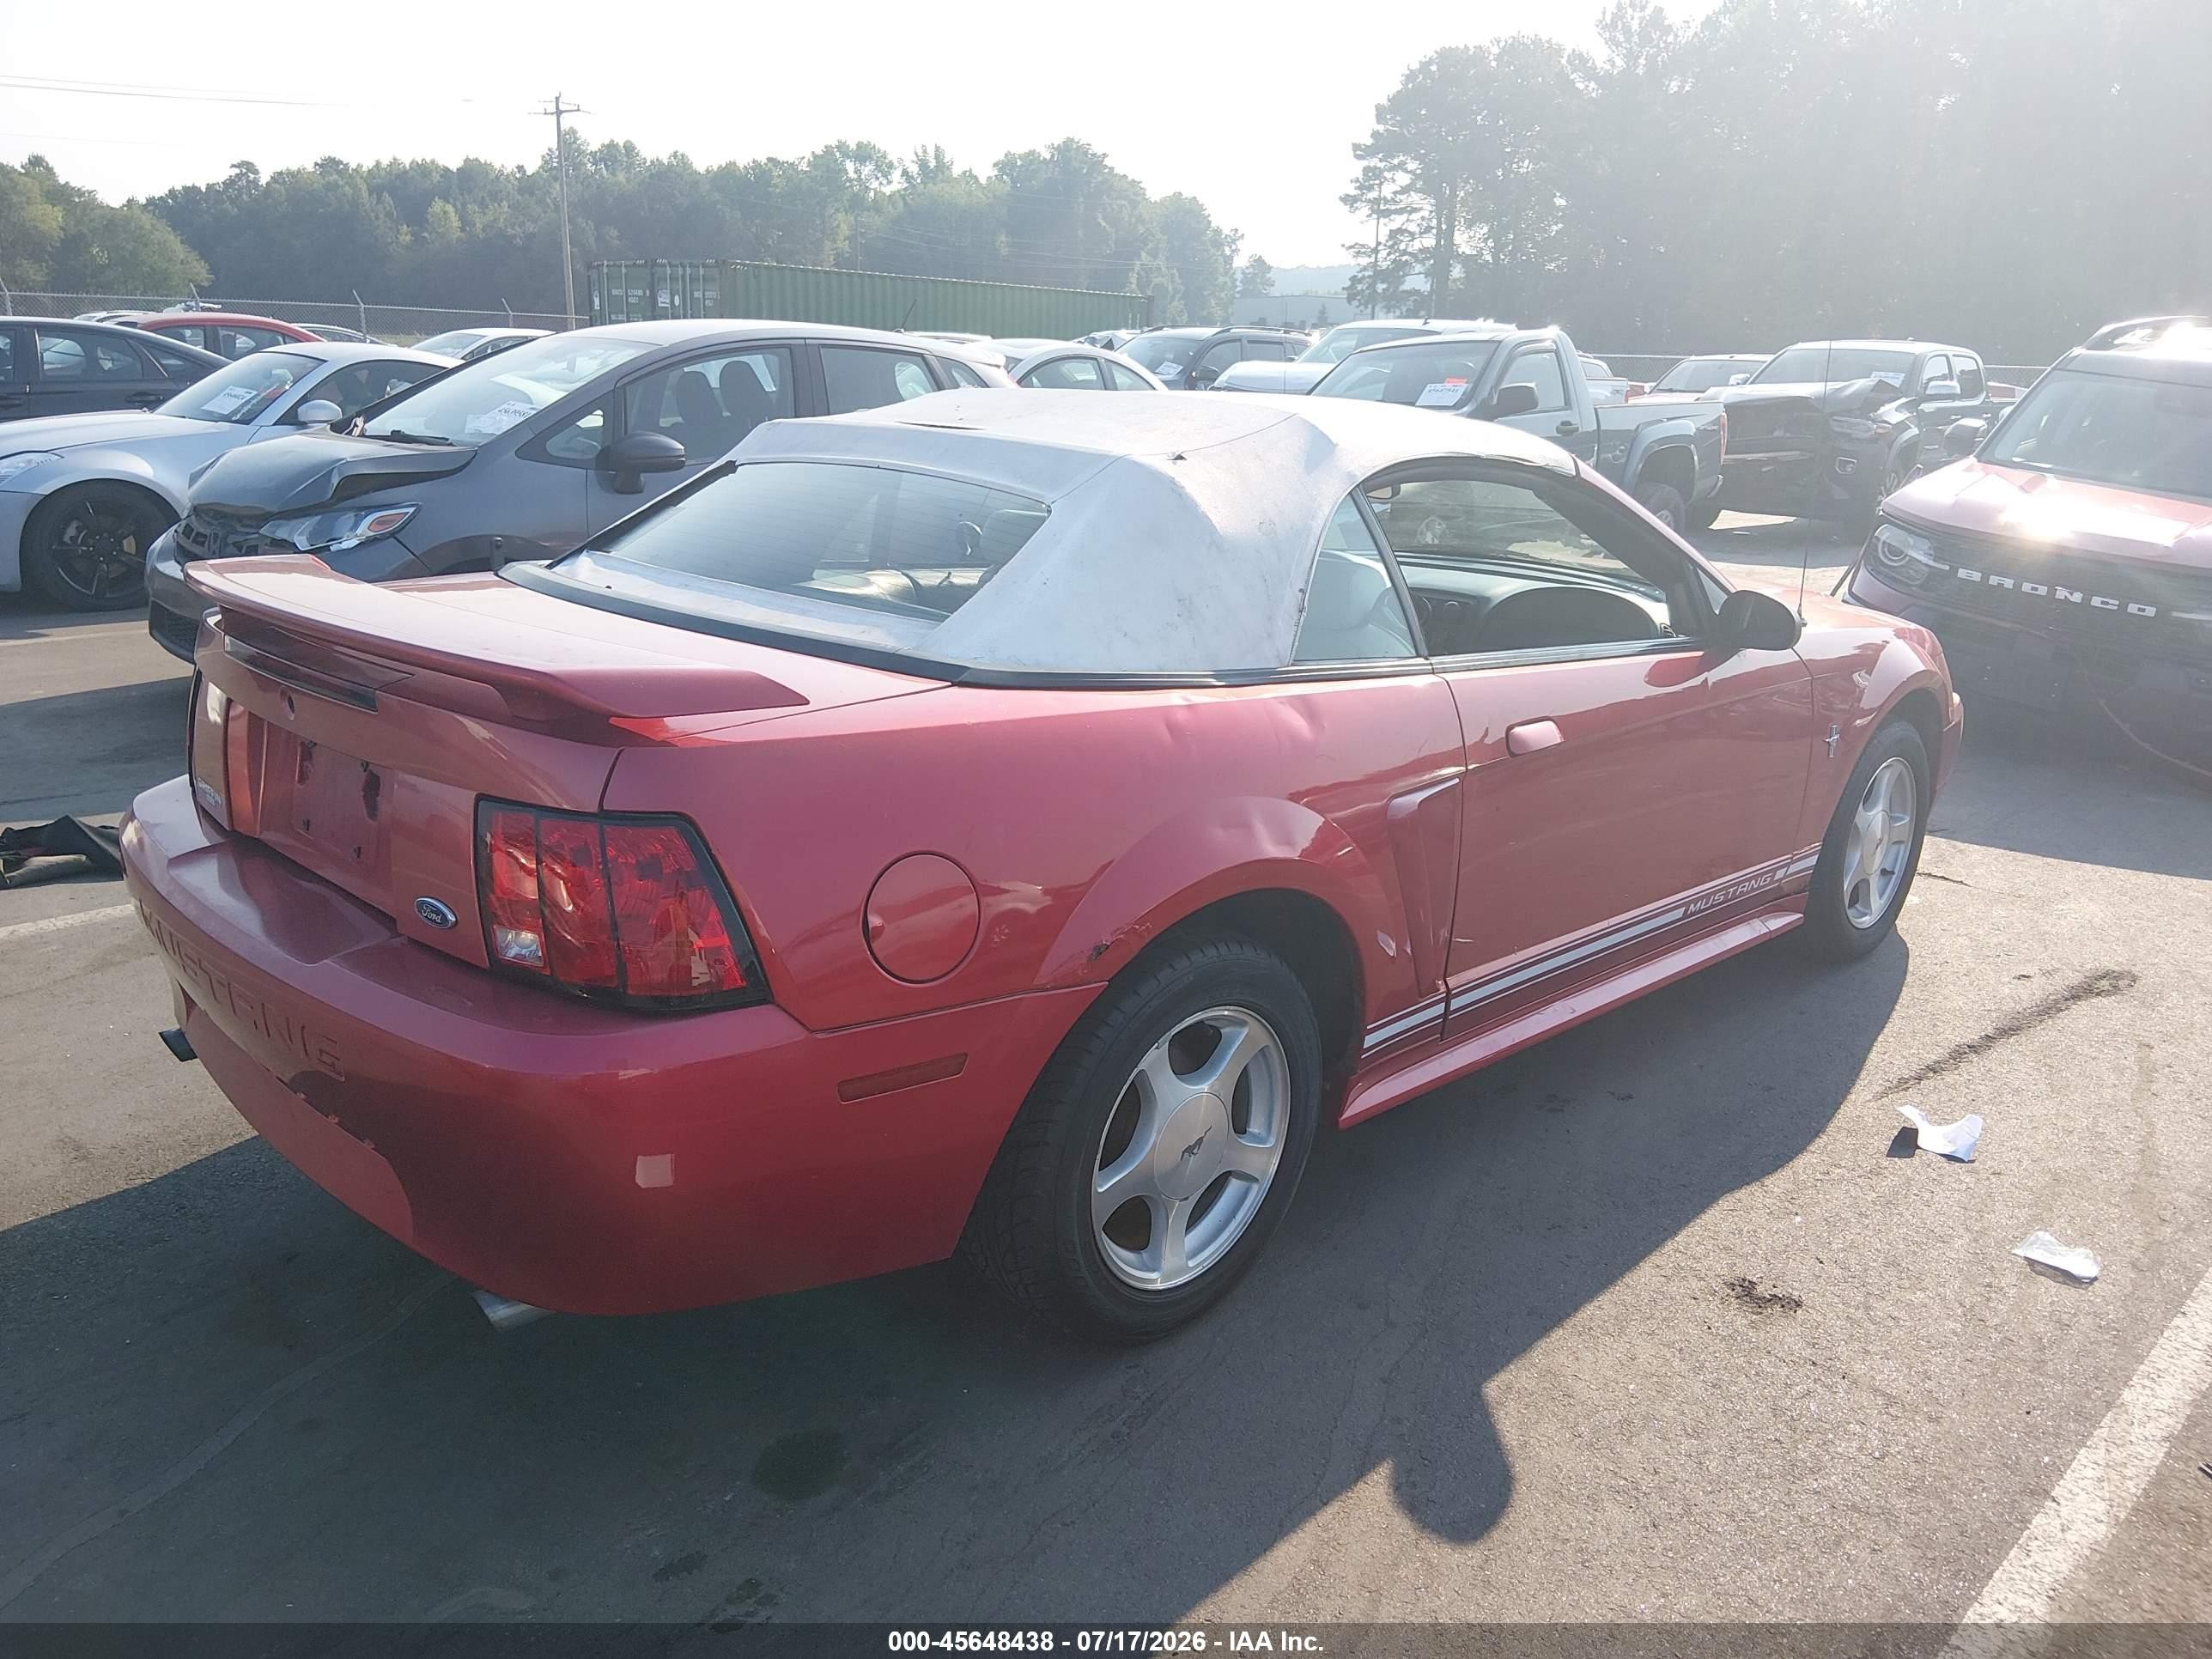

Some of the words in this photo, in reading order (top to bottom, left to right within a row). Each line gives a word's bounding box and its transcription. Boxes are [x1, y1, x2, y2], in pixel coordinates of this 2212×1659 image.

[1957, 567, 2157, 618] BRONCO
[422, 903, 443, 923] Ford
[1686, 872, 1773, 915] MUSTANG
[139, 898, 345, 1082] MUSTANG
